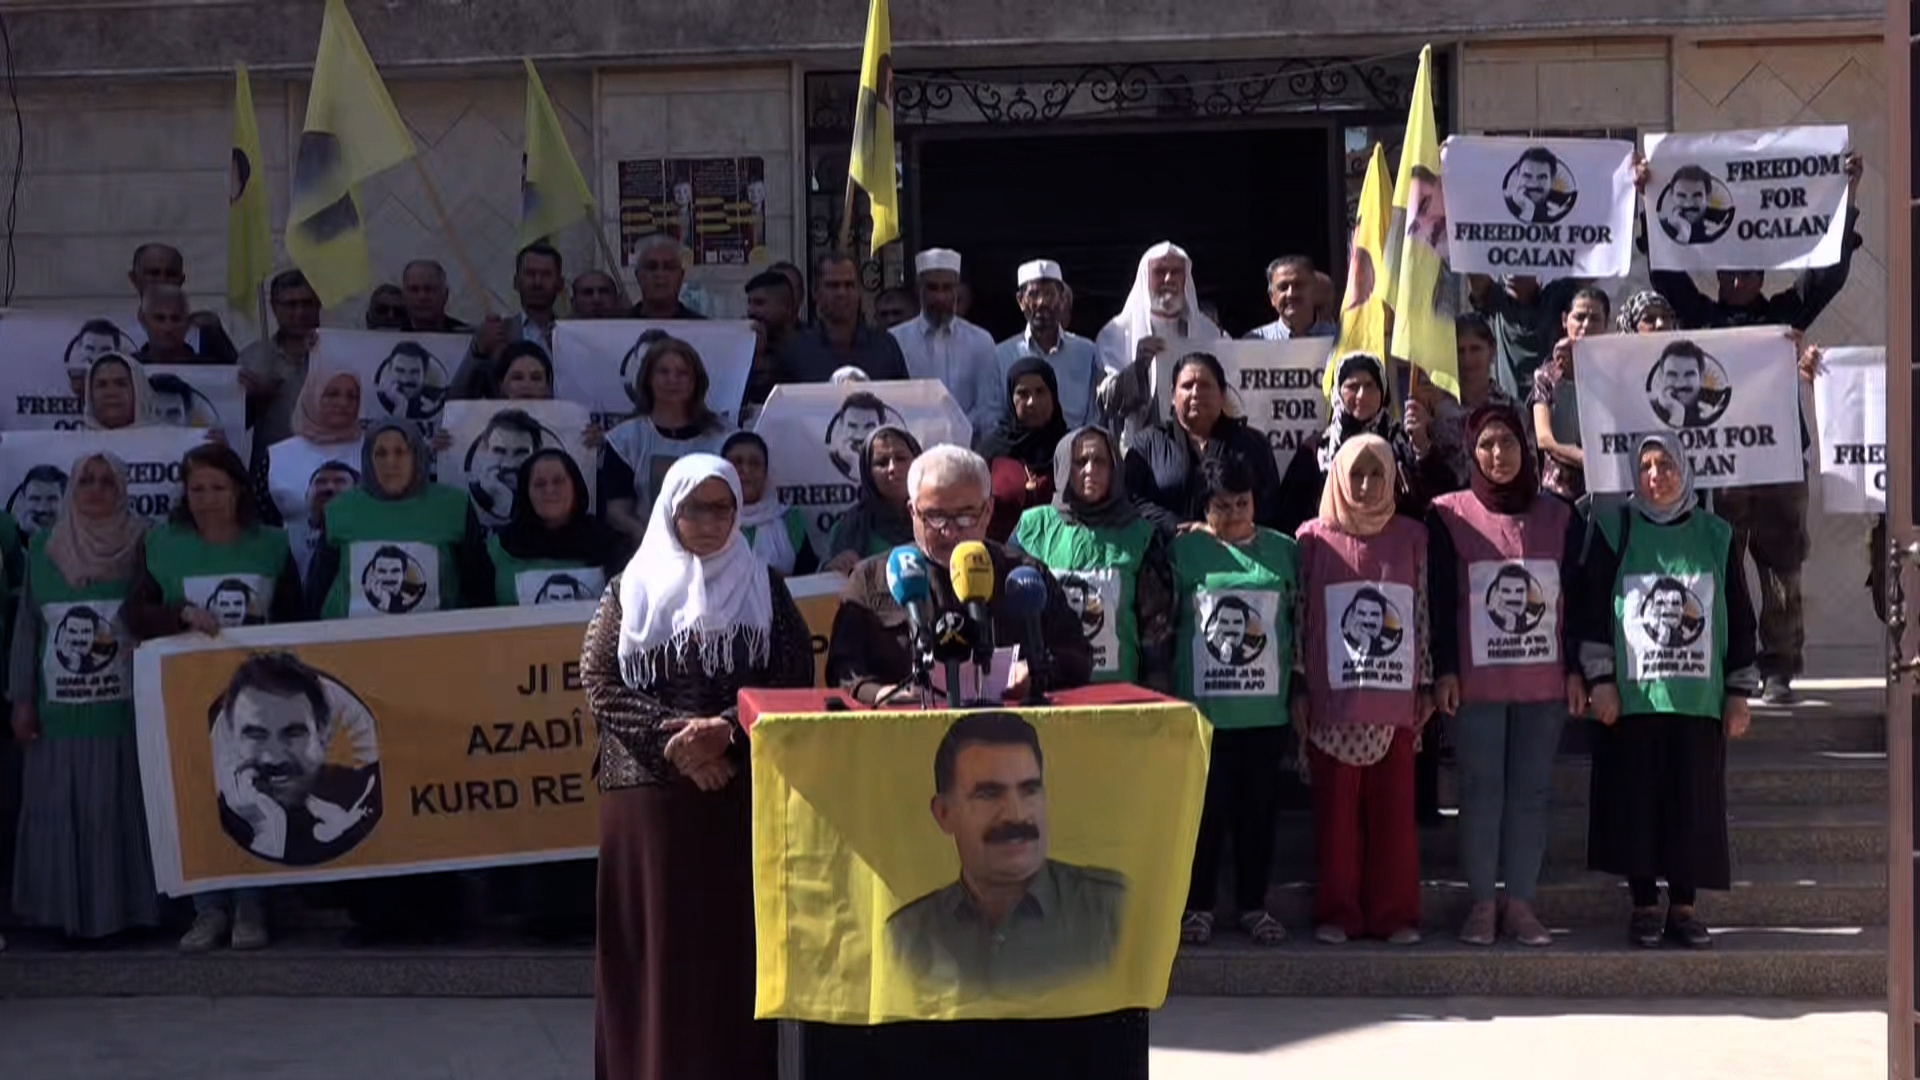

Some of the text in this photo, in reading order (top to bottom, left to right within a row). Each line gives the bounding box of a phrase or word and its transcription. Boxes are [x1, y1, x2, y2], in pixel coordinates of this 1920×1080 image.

[1726, 154, 1841, 182] FREEDOM
[1760, 187, 1807, 209] FOR
[1455, 222, 1613, 244] FREEDOM FOR
[1737, 214, 1831, 240] OCALAN
[1487, 247, 1576, 267] OCALAN
[1240, 368, 1325, 390] FREEDO
[1272, 399, 1318, 420] FOR
[1724, 425, 1776, 448] FOR
[776, 483, 862, 506] FREED
[518, 664, 549, 697] JI
[467, 708, 583, 756] AZADÎ
[410, 773, 585, 816] KURD RE
